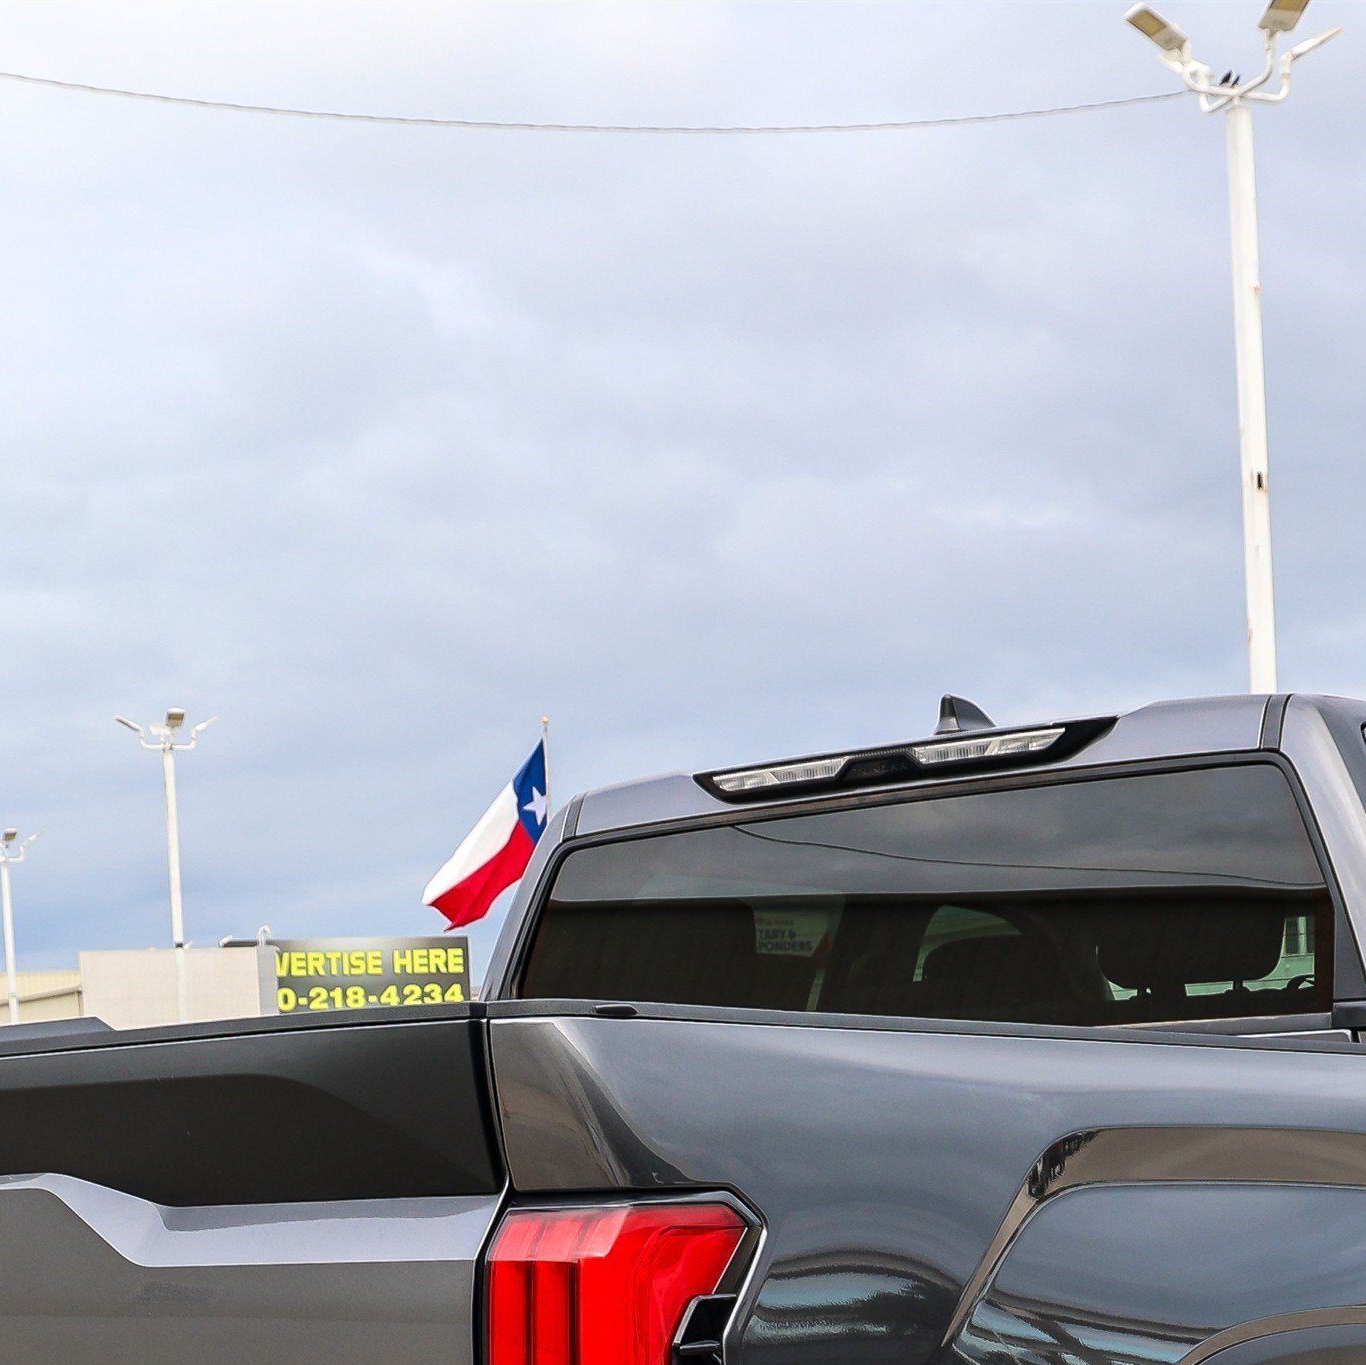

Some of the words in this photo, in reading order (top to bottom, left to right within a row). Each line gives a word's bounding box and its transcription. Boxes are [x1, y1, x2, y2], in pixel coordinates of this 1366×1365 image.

[276, 951, 383, 977] VERTISE
[393, 948, 464, 974] HERE
[277, 983, 465, 1012] 0-218-4234
